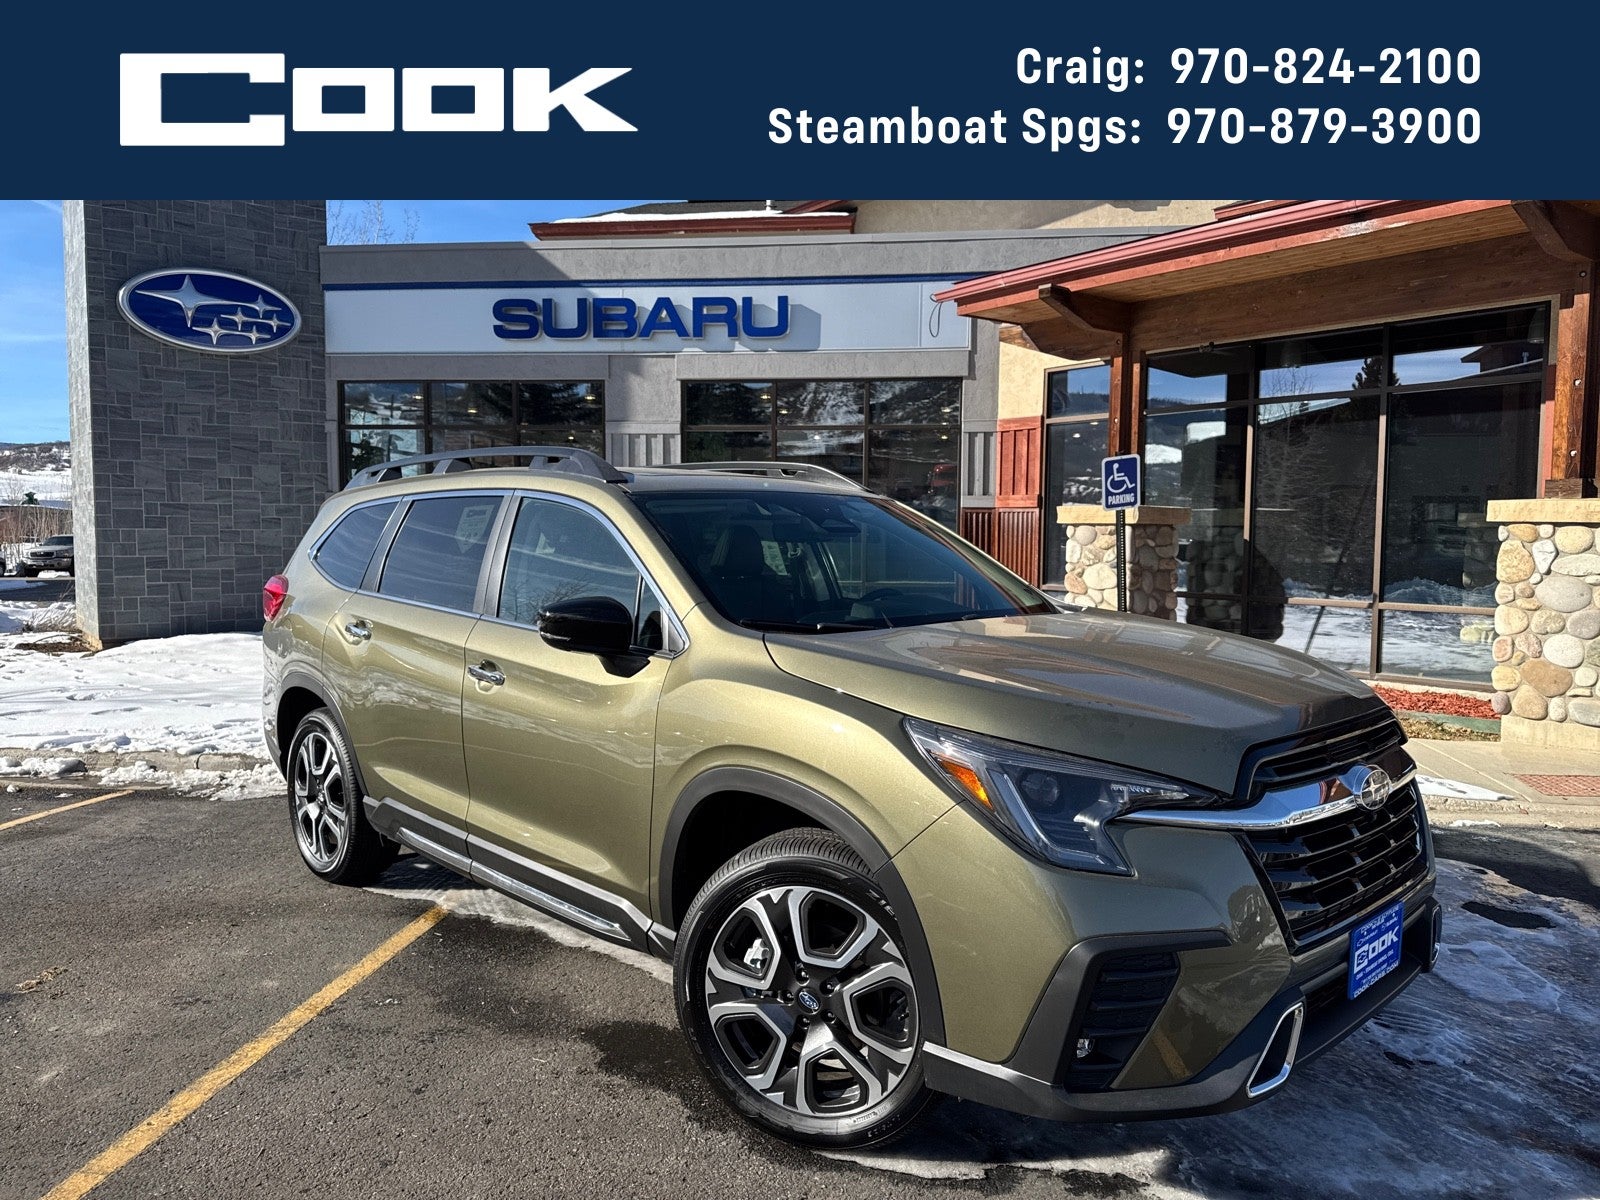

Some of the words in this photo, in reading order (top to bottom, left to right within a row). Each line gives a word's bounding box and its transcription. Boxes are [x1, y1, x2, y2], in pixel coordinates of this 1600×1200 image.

[492, 295, 789, 339] SUBARU
[1108, 493, 1135, 506] PARKING
[1353, 925, 1400, 975] COOK
